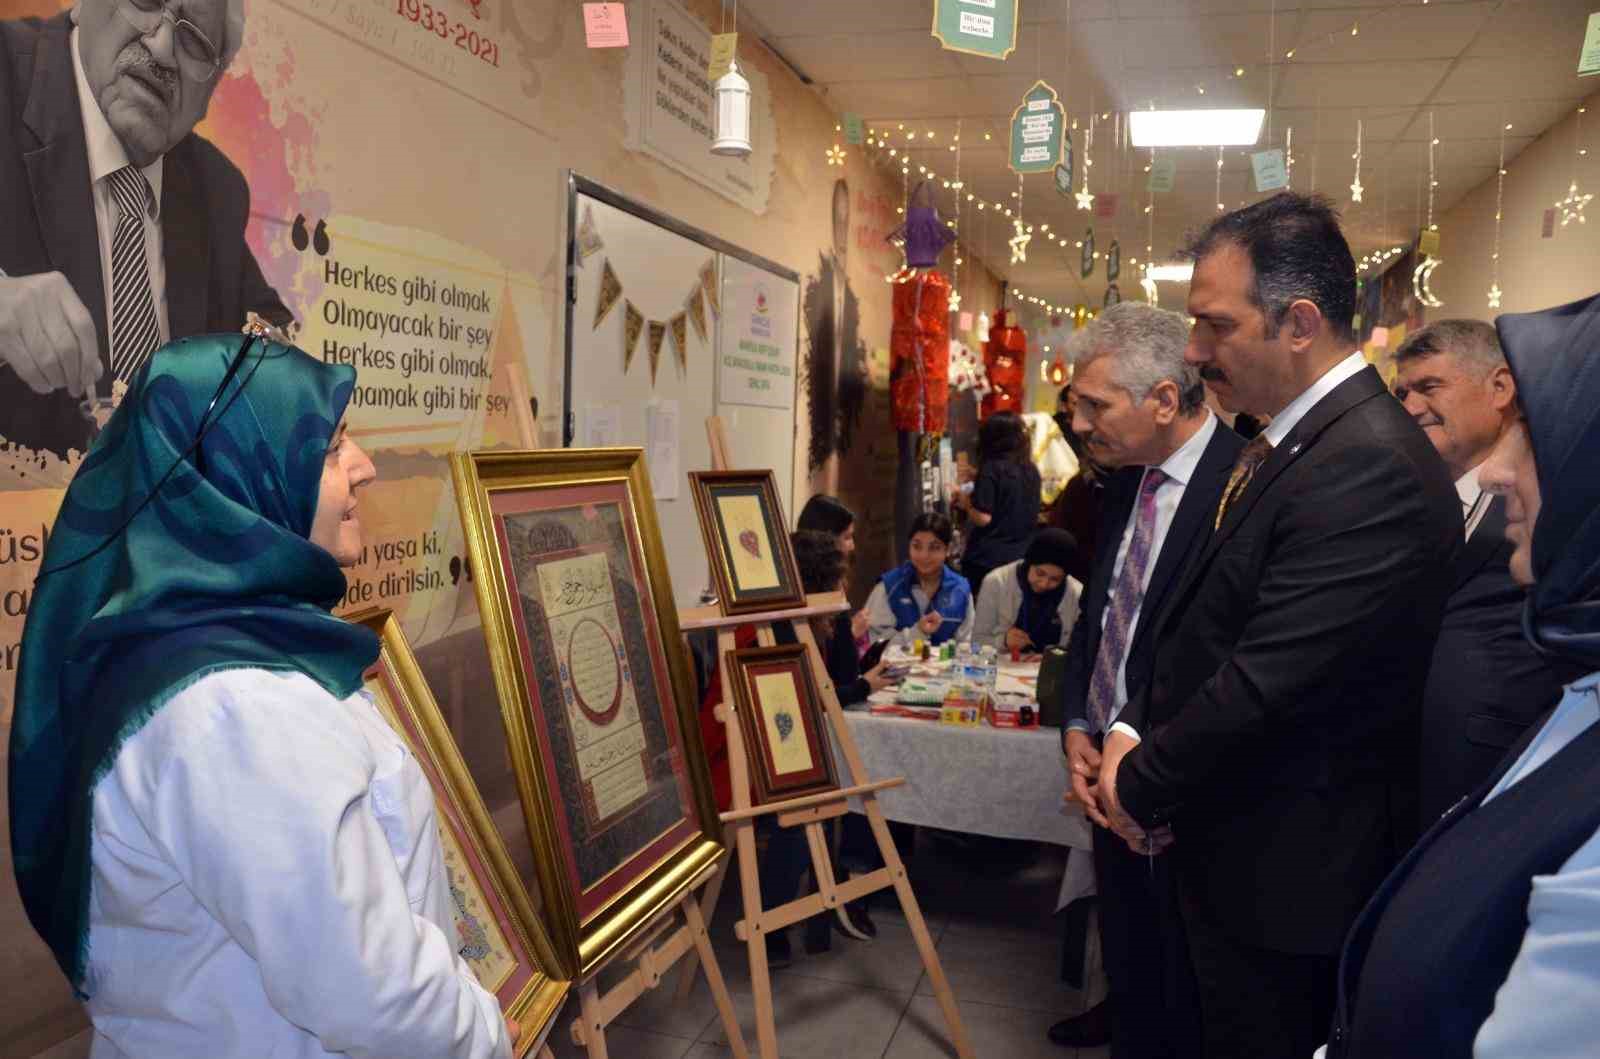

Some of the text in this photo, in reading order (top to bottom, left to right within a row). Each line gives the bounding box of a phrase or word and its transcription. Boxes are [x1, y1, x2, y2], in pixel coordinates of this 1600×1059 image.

[397, 0, 500, 68] 1933-2021
[324, 259, 491, 313] Herkes gibi olmak
[323, 297, 493, 350] Olmayacak bir şey
[323, 339, 493, 381] Herkes gibi olmak,
[352, 383, 511, 417] mamak gibi bir şey
[374, 539, 417, 569] yaşa
[379, 566, 445, 598] dirilsin.
